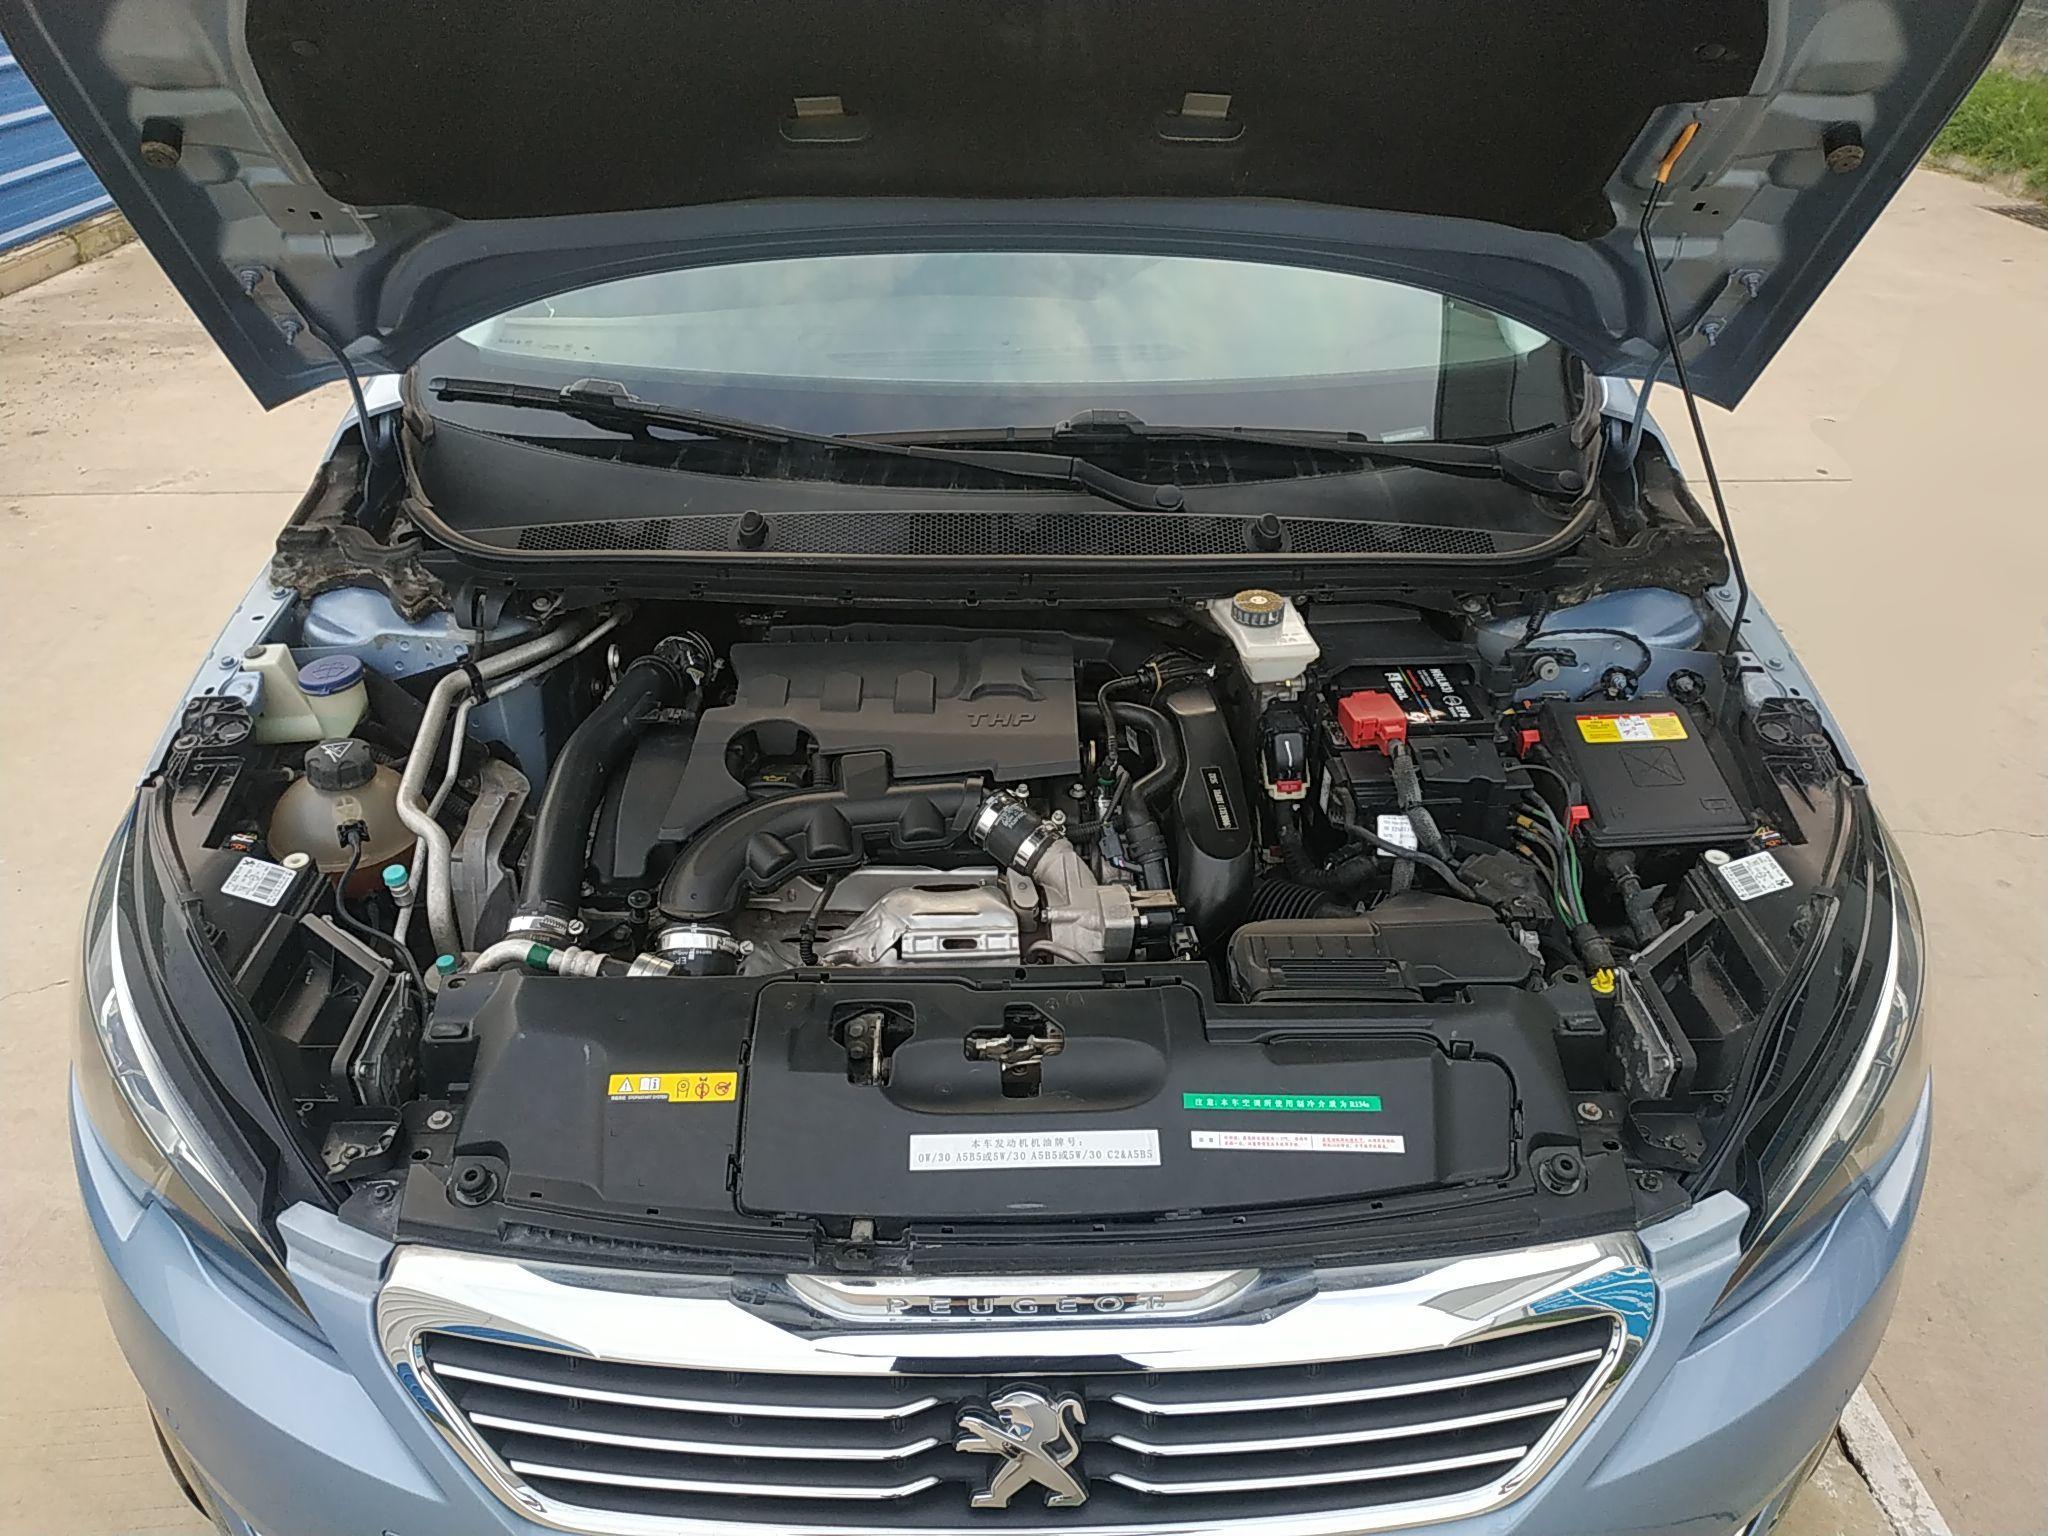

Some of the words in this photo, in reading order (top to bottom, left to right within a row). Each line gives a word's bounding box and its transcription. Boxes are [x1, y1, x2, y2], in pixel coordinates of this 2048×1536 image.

[968, 713, 1036, 727] THP
[1107, 1147, 1153, 1159] C2&A5B5
[885, 1295, 1166, 1315] PEUGEOT
